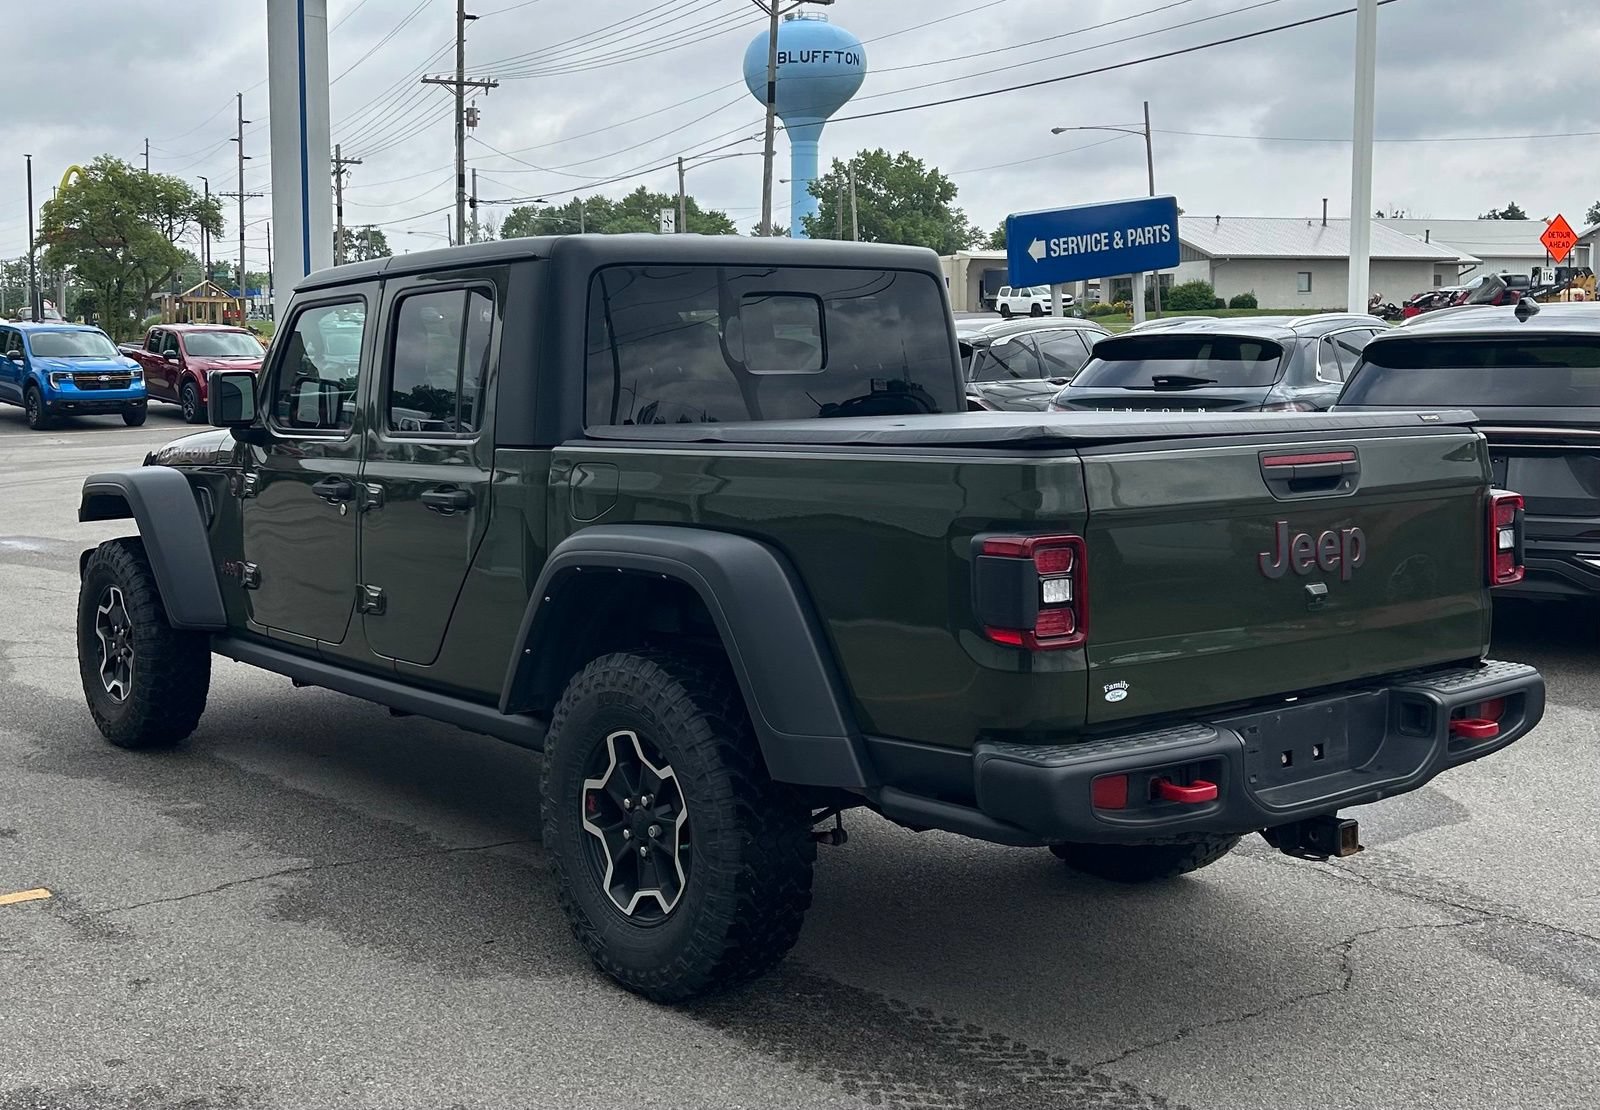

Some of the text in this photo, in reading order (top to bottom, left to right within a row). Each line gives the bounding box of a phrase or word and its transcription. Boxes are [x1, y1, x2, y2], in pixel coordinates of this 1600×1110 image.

[777, 50, 860, 66] BLUFFTON
[1050, 223, 1171, 258] SERVICE & PARTS
[1548, 231, 1571, 239] DETOUR
[1548, 240, 1571, 249] AHEAD
[1542, 271, 1554, 281] 116
[1258, 521, 1366, 581] Jeep
[1103, 680, 1130, 692] Family
